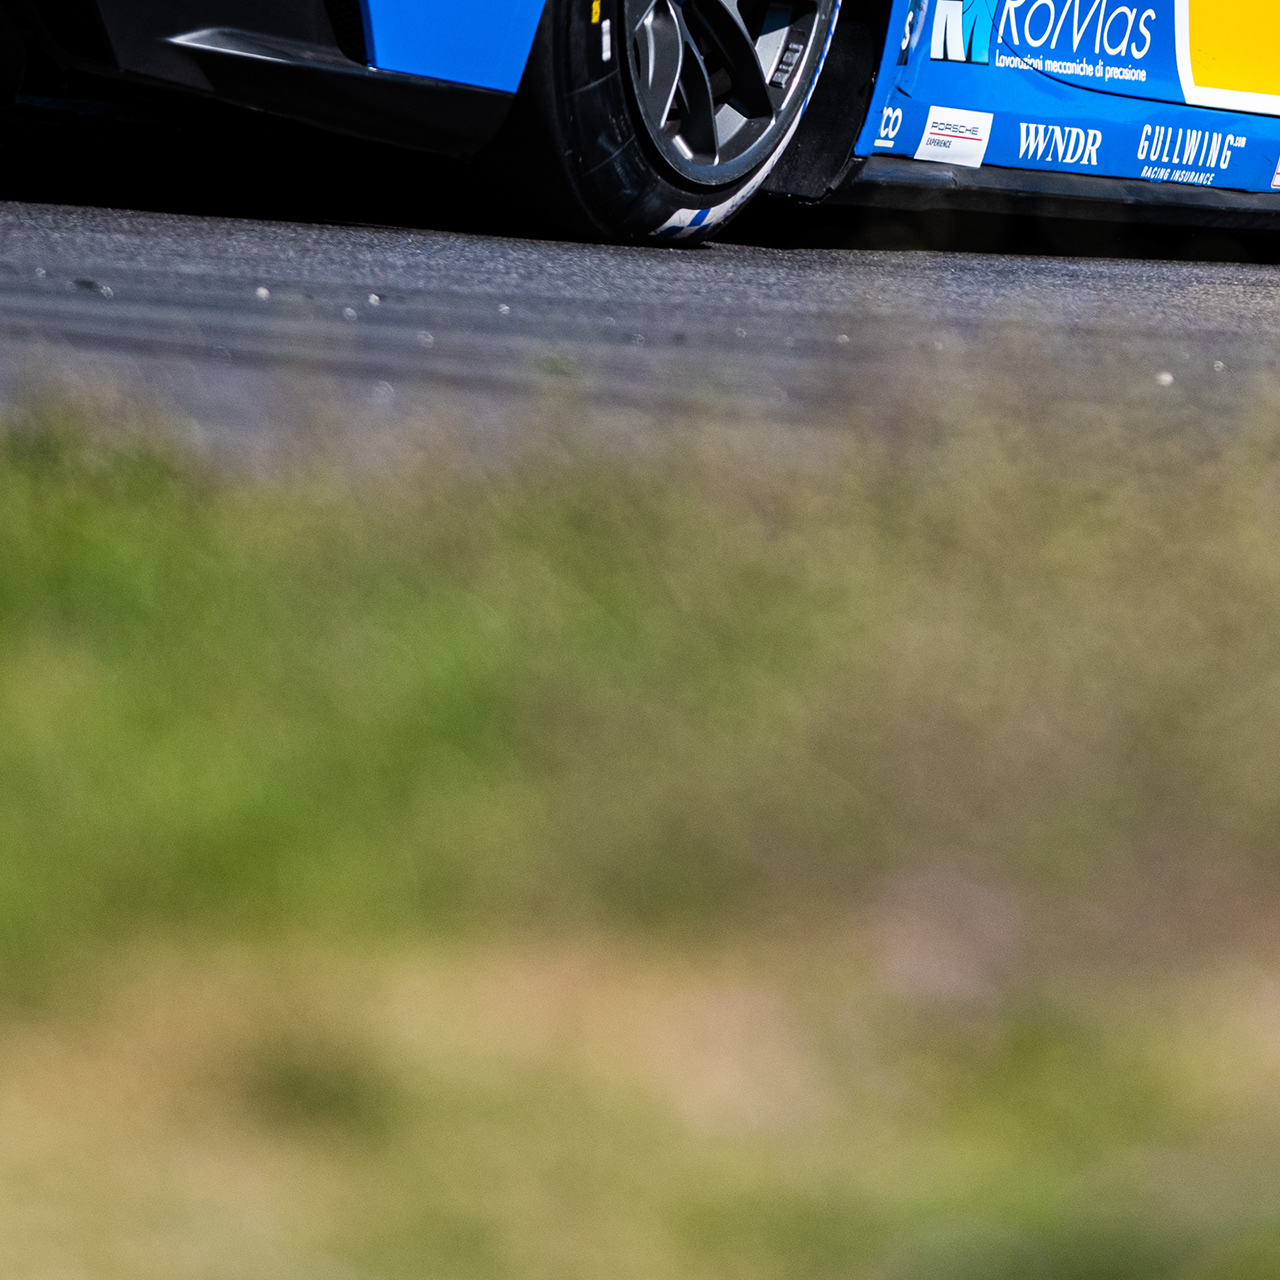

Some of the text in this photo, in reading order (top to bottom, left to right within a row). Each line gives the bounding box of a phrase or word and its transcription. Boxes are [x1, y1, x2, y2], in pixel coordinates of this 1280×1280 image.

[995, 49, 1147, 82] Lavorazioni meccaniche di precisione
[931, 121, 980, 136] PORSCHE
[925, 137, 952, 149] EXPERIENCE
[1018, 122, 1103, 166] WNDR
[1140, 165, 1215, 185] RACING INSURANCE
